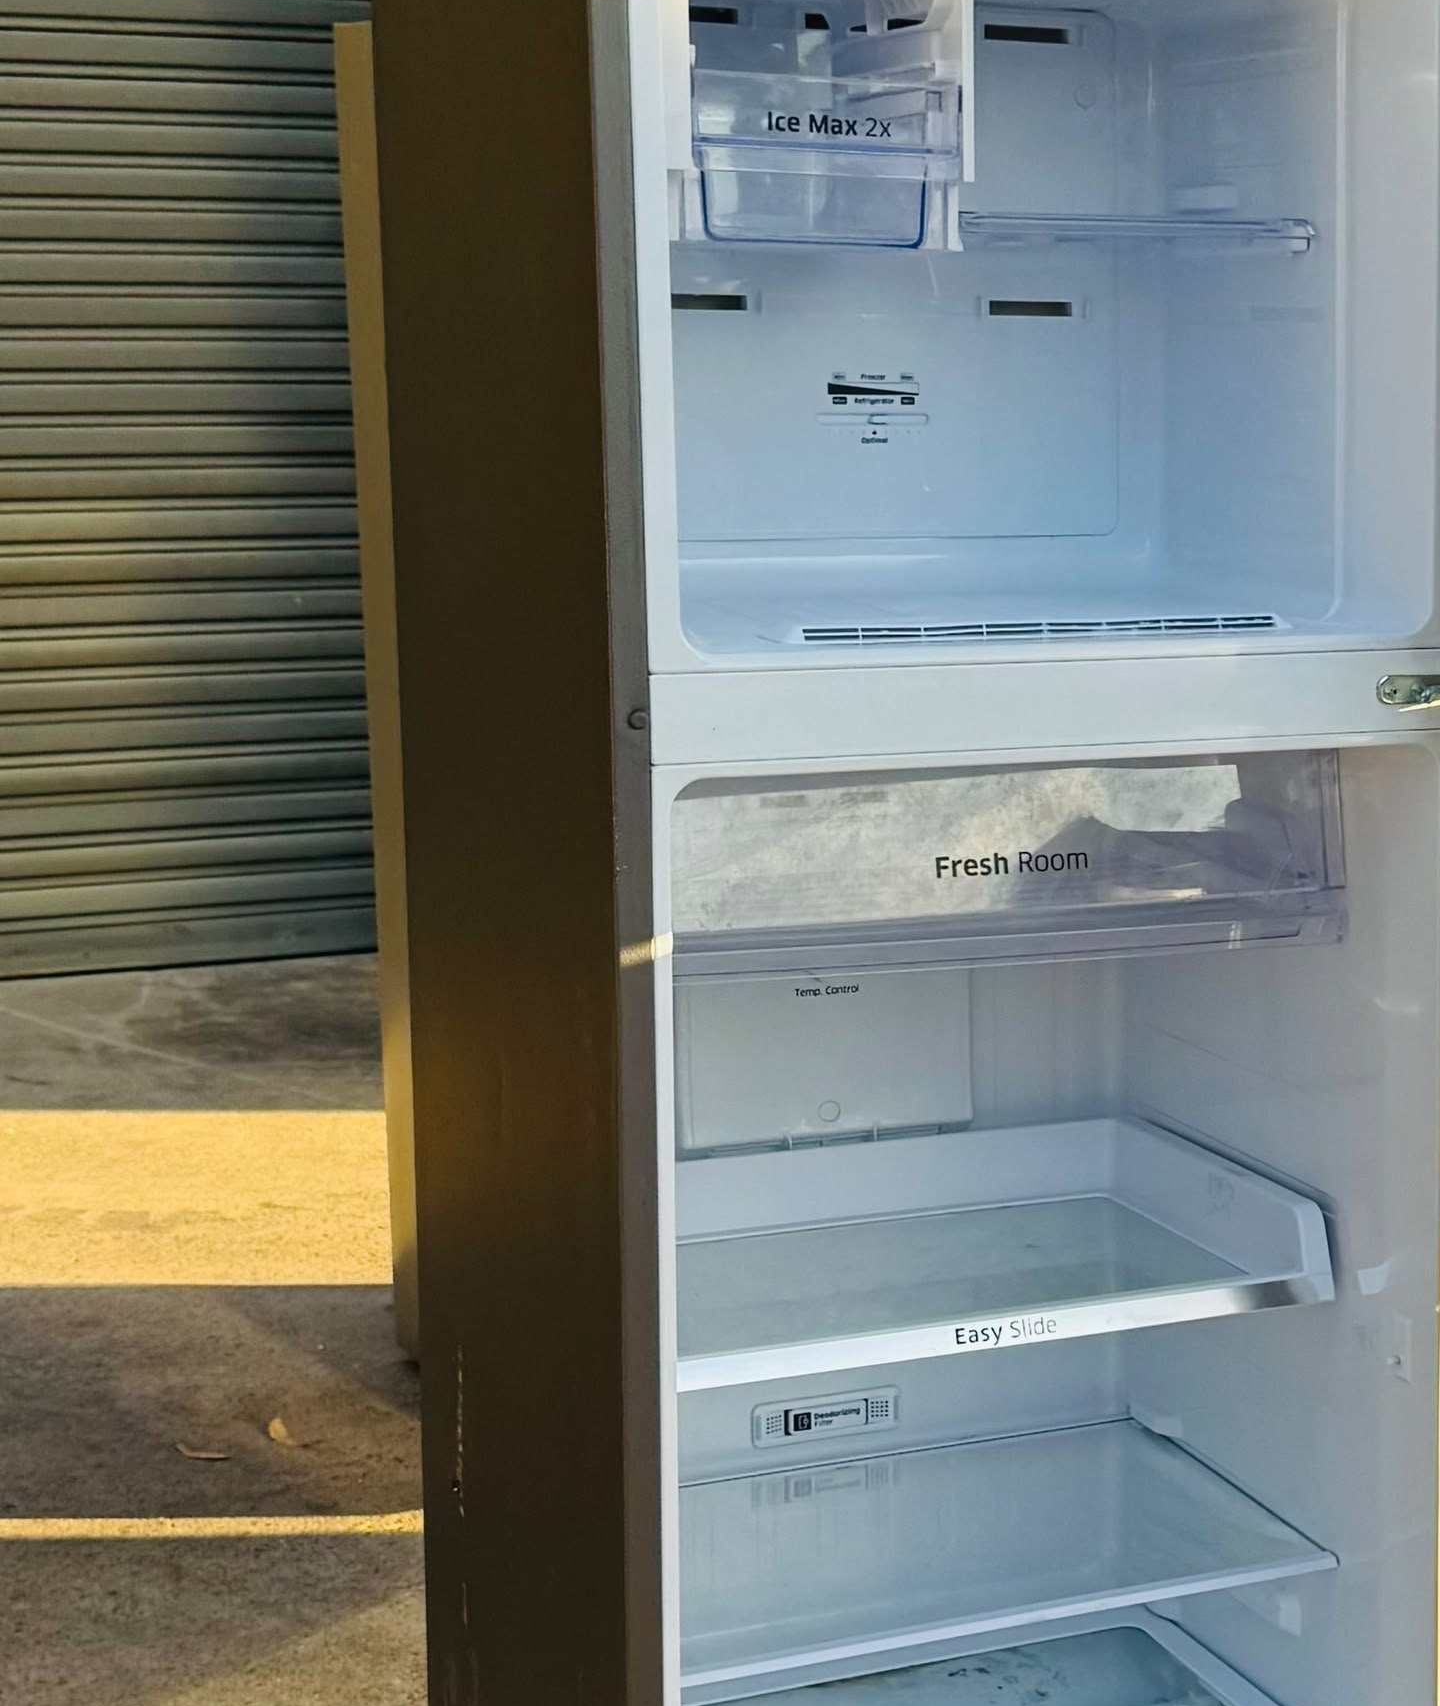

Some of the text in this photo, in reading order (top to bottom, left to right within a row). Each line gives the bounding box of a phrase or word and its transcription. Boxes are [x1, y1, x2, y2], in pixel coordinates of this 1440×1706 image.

[767, 111, 891, 137] Ice Max 2x
[935, 851, 1088, 879] Fresh Room
[825, 983, 860, 995] Control
[955, 1317, 1057, 1346] Easy Slide
[813, 1407, 861, 1420] Deodorizing
